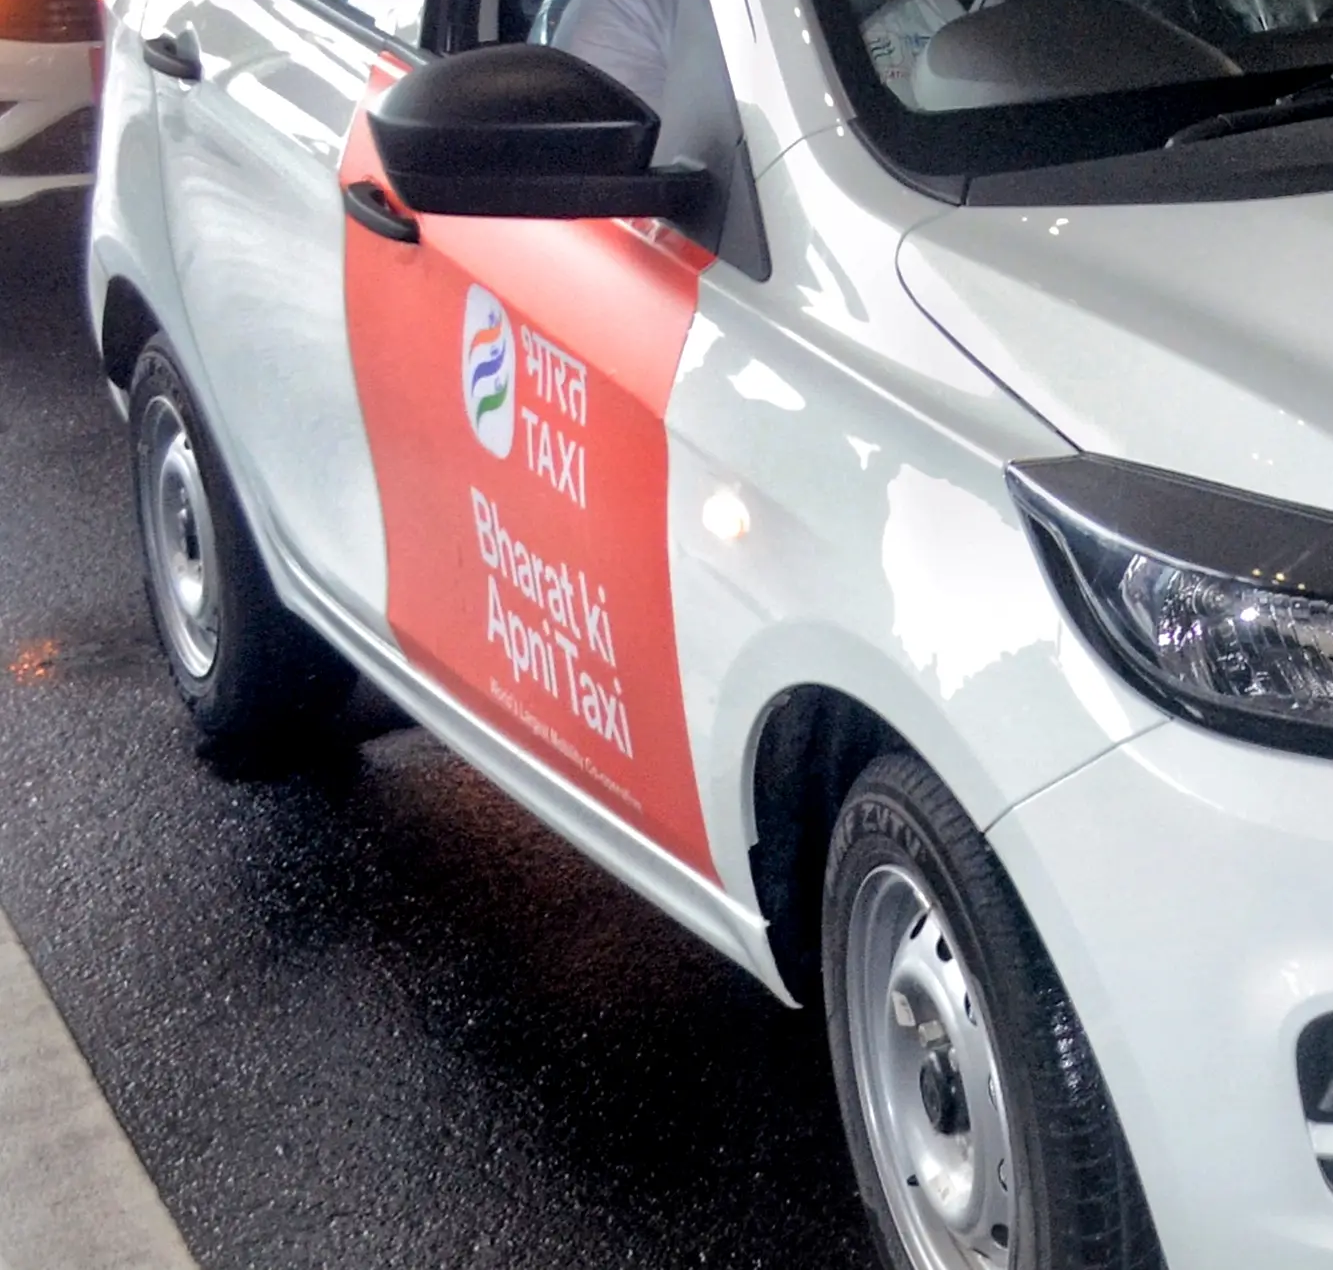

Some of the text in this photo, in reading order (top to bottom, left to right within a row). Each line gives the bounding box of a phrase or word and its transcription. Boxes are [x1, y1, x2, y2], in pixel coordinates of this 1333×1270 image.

[521, 324, 586, 427] भारत
[521, 405, 586, 509] TAXI
[470, 485, 616, 667] Bharat ki
[487, 574, 633, 760] Apni Taxi
